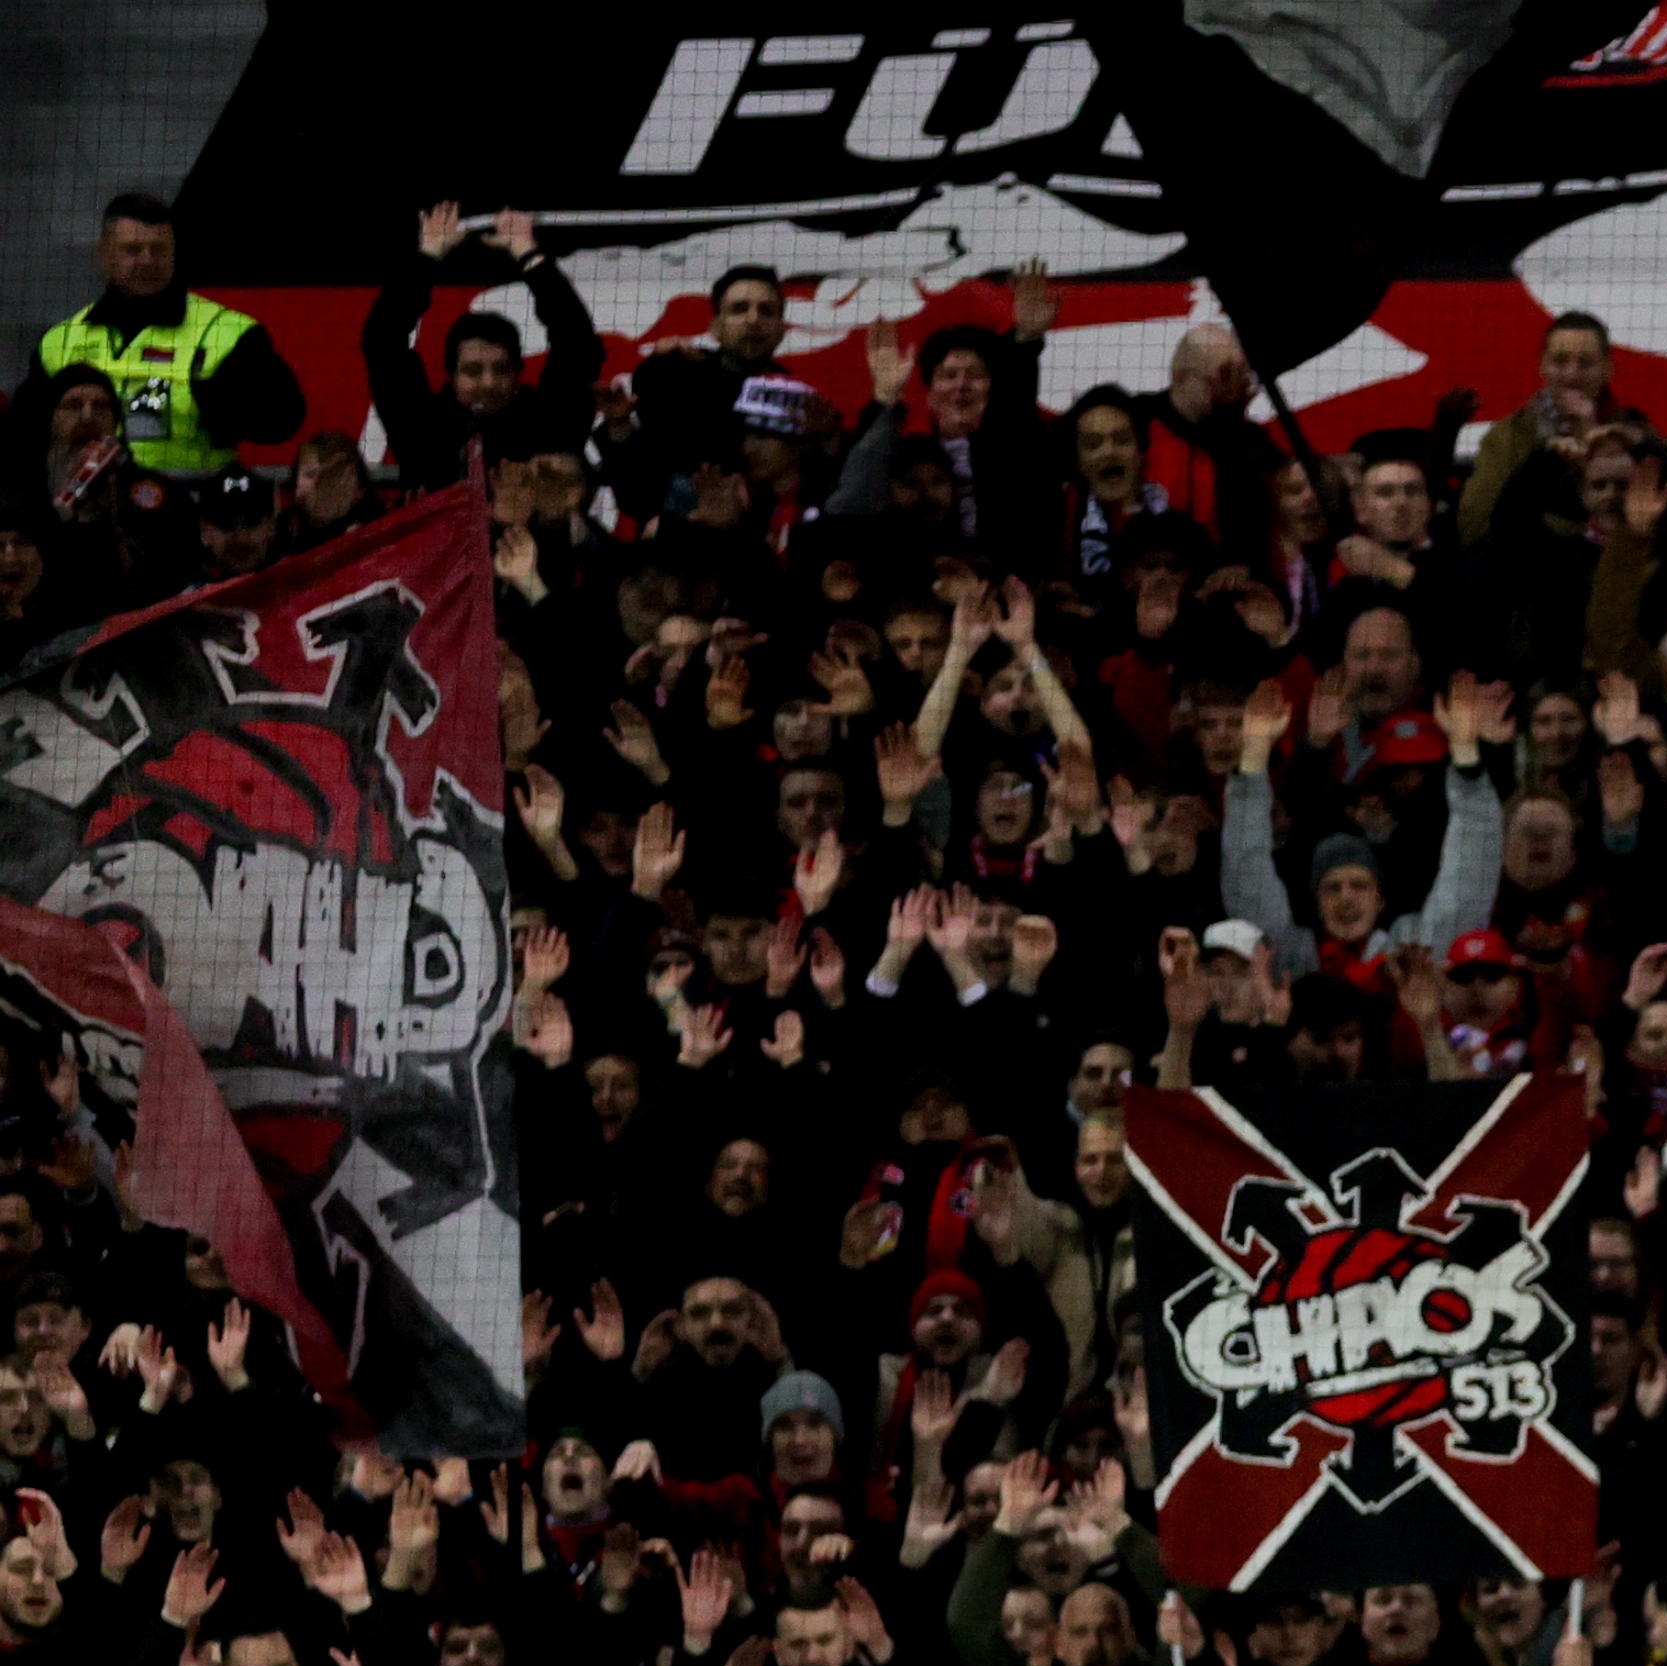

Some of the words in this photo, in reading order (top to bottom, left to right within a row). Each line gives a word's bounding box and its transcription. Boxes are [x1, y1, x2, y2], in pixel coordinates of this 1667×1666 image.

[618, 20, 1145, 175] FÜ
[1184, 1243, 1543, 1393] CHAOS
[1451, 1360, 1549, 1420] 513
